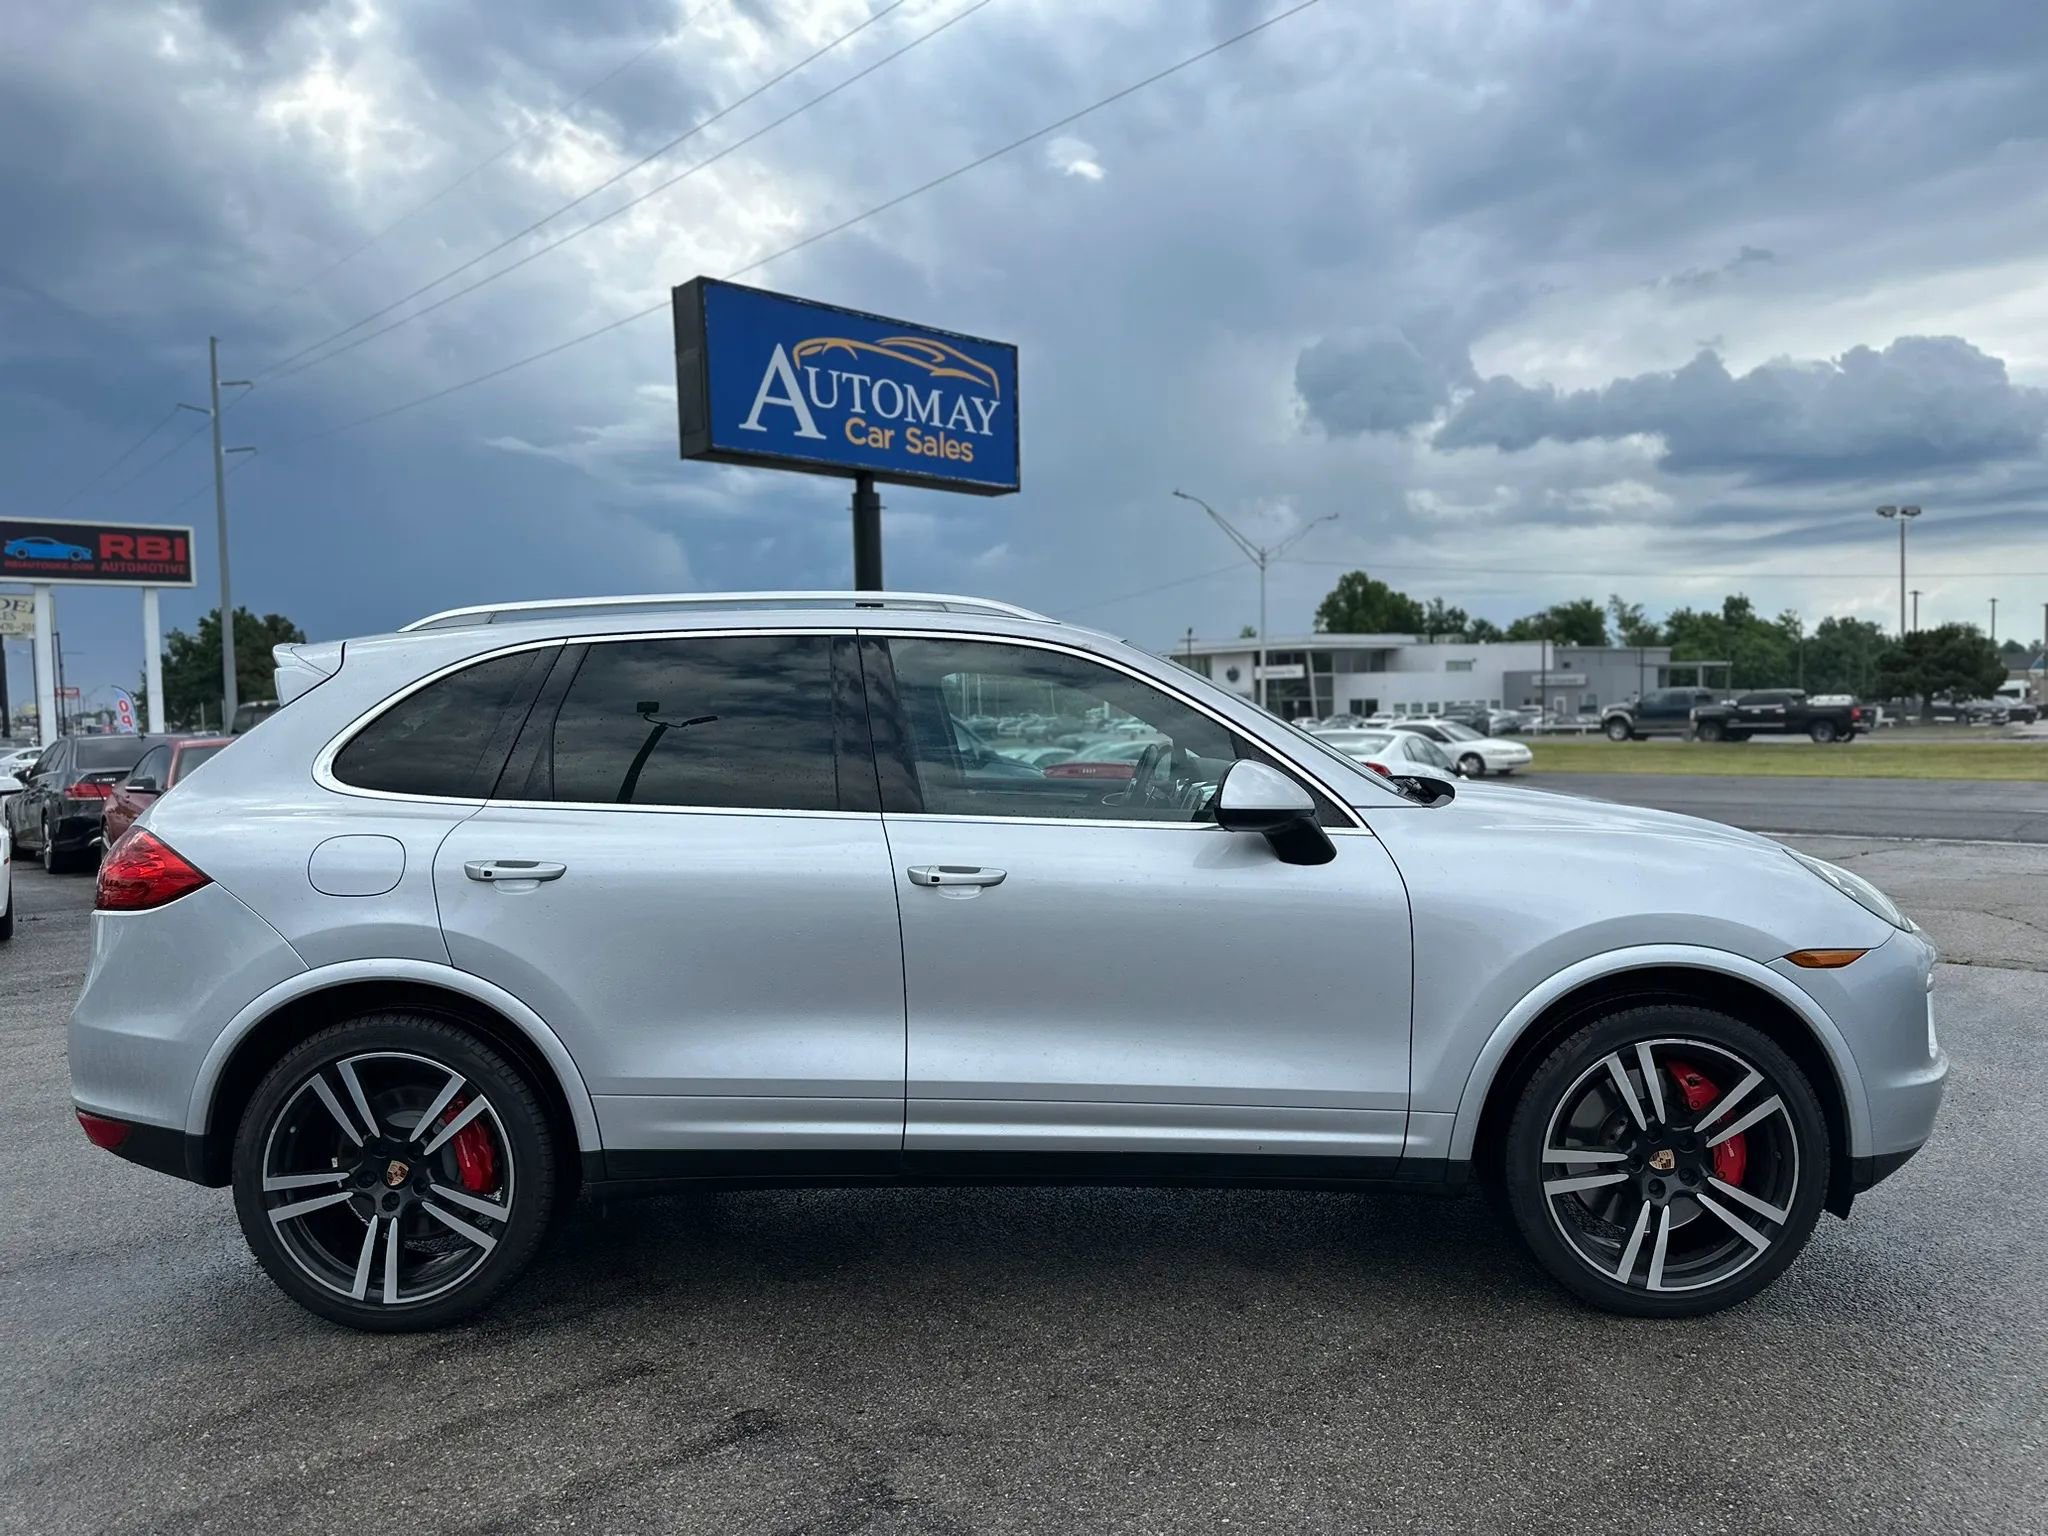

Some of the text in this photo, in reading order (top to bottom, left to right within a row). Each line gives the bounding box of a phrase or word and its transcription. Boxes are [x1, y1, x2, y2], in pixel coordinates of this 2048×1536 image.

[738, 342, 1000, 440] AUTOMAY
[844, 417, 974, 462] Car Sales
[100, 534, 186, 561] RBI
[101, 562, 186, 575] AUTOMOTIVE
